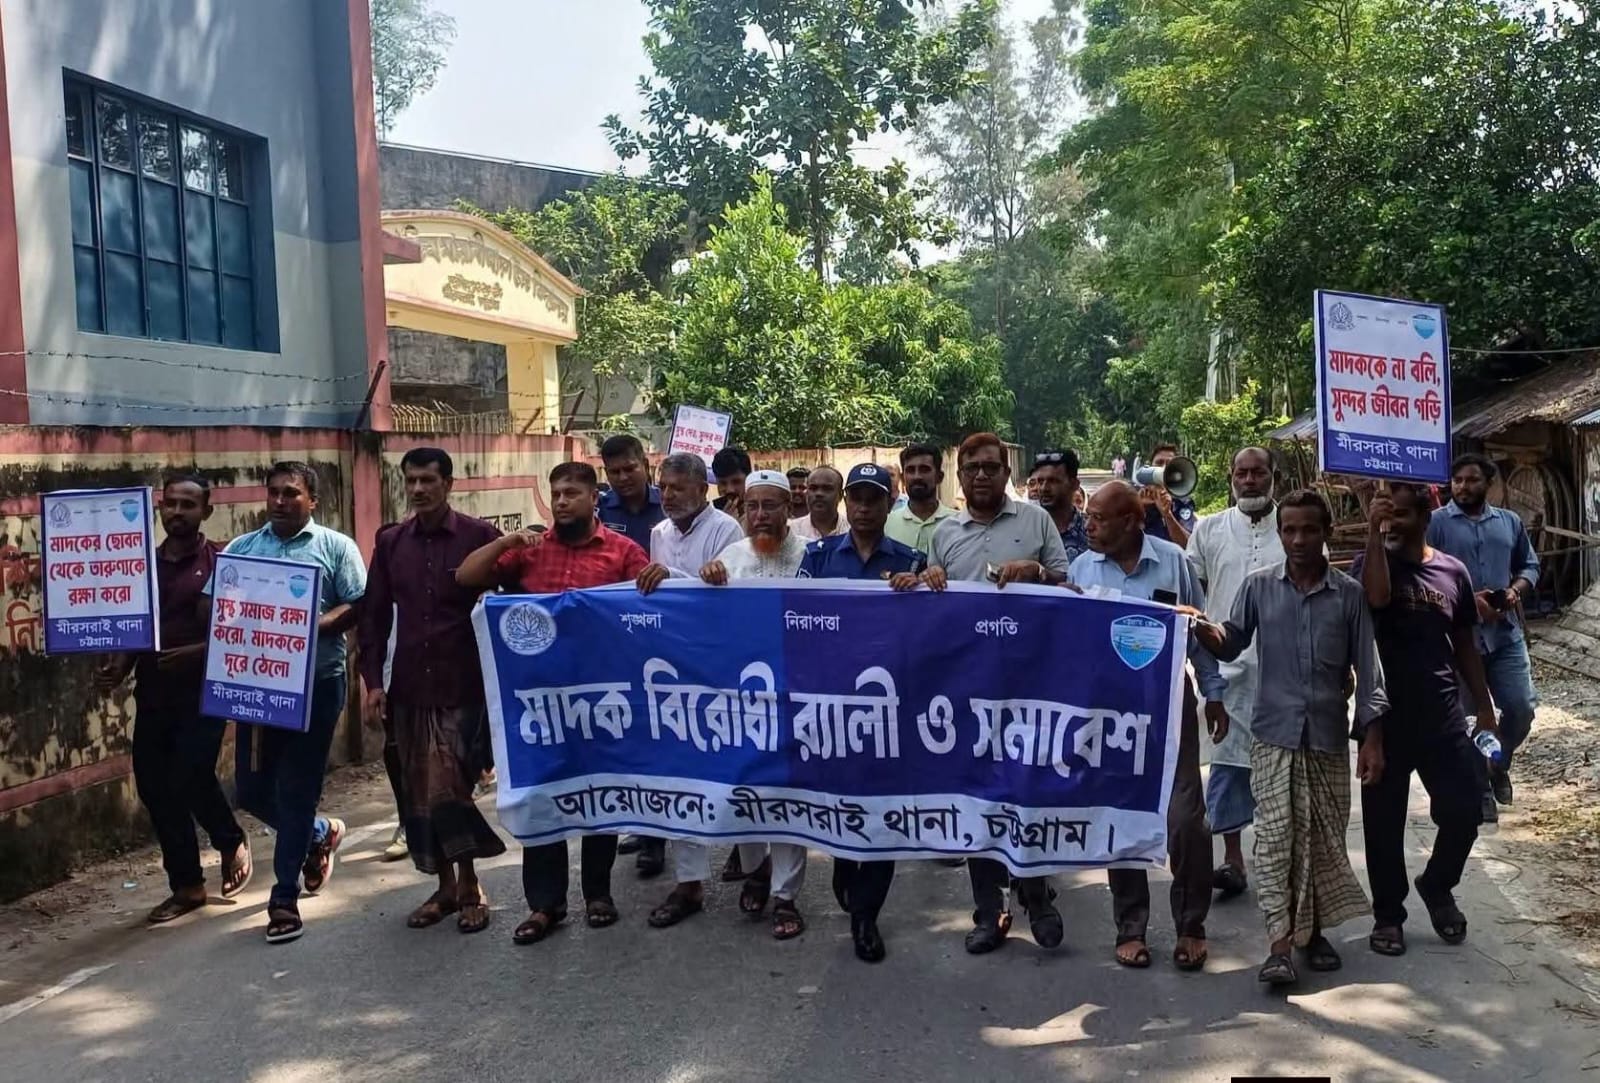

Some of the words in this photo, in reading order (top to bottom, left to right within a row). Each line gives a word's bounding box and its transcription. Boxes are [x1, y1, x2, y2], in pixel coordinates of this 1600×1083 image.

[1328, 350, 1387, 380] মাদককে
[1391, 358, 1405, 381] না
[1410, 351, 1441, 387] বলি,
[1331, 387, 1367, 423] সুন্দর
[1371, 383, 1409, 419] জীবন
[1414, 390, 1441, 426] গড়ি
[1336, 432, 1401, 459] মীরসরাই
[1405, 445, 1438, 463] থানা
[50, 534, 101, 554] মাদকের
[105, 532, 143, 552] ছোবল
[50, 561, 85, 582] থেকে
[89, 558, 145, 578] তারুণ্যকে
[68, 587, 96, 607] রক্ষা
[99, 585, 131, 605] করো
[56, 618, 112, 635] মীরসরাই
[116, 618, 143, 632] থানা
[216, 598, 236, 623] সুস্থ
[240, 601, 276, 623] সমাজ
[280, 606, 308, 627] রক্ষা
[784, 610, 840, 632] নিরাপত্তা
[974, 615, 1019, 637] প্রগতি
[213, 624, 247, 647] করো,
[252, 629, 307, 653] মাদককে
[224, 653, 249, 680] দূরে
[252, 653, 290, 678] ঠেলো
[212, 682, 265, 706] মীরসরাই
[269, 694, 297, 711] থানা
[514, 681, 633, 746] মাদক
[643, 657, 778, 752] বিরোধী
[916, 694, 957, 754] ও
[969, 697, 1152, 778] সমাবেশ
[552, 783, 715, 825] আয়োজনে:
[726, 786, 873, 843] মীরসরাই
[883, 803, 973, 848] থানা,
